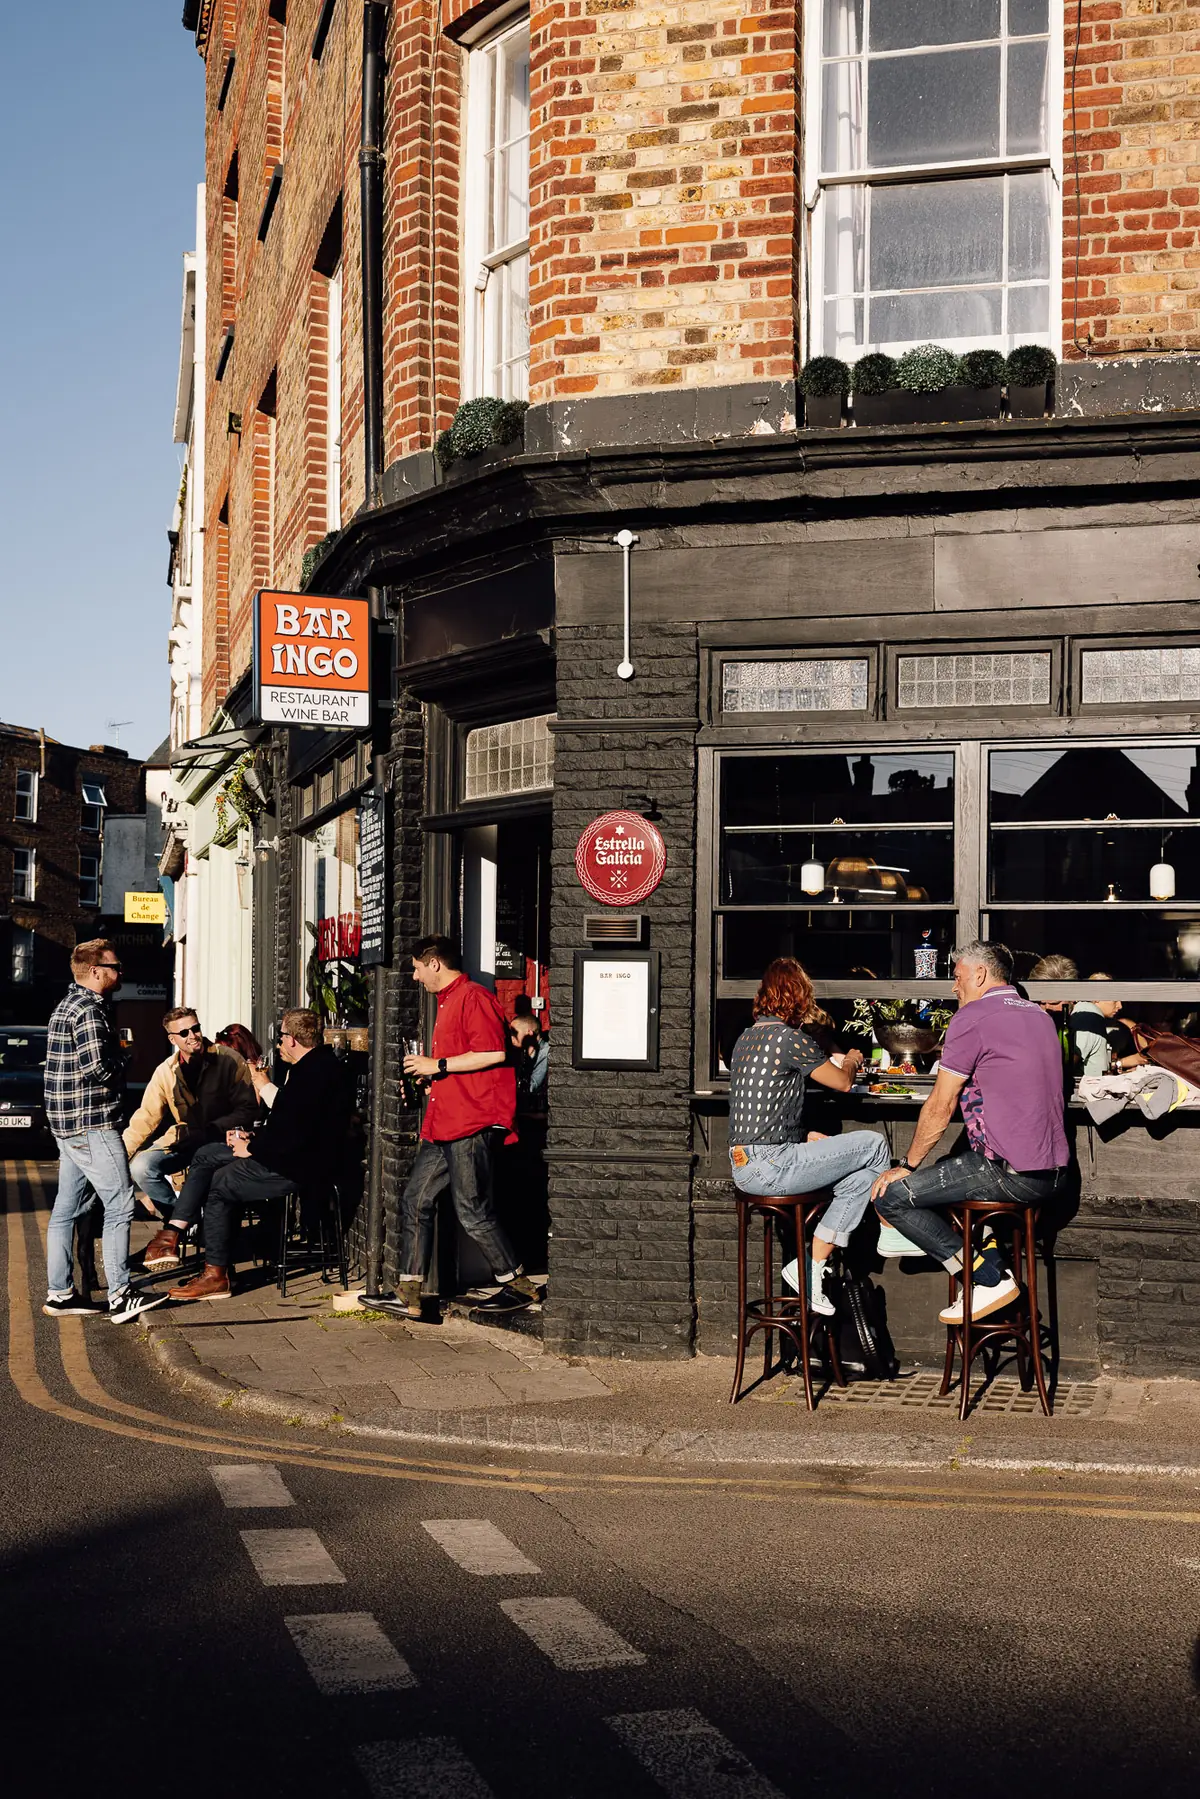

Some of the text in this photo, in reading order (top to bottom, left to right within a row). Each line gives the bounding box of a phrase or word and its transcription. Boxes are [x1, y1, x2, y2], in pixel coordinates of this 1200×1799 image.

[274, 604, 355, 641] BAR
[270, 691, 358, 707] RESTAURANT
[281, 708, 349, 722] WINE BAR
[594, 836, 645, 851] Estrella
[595, 850, 642, 865] Galicia
[131, 912, 159, 920] Change
